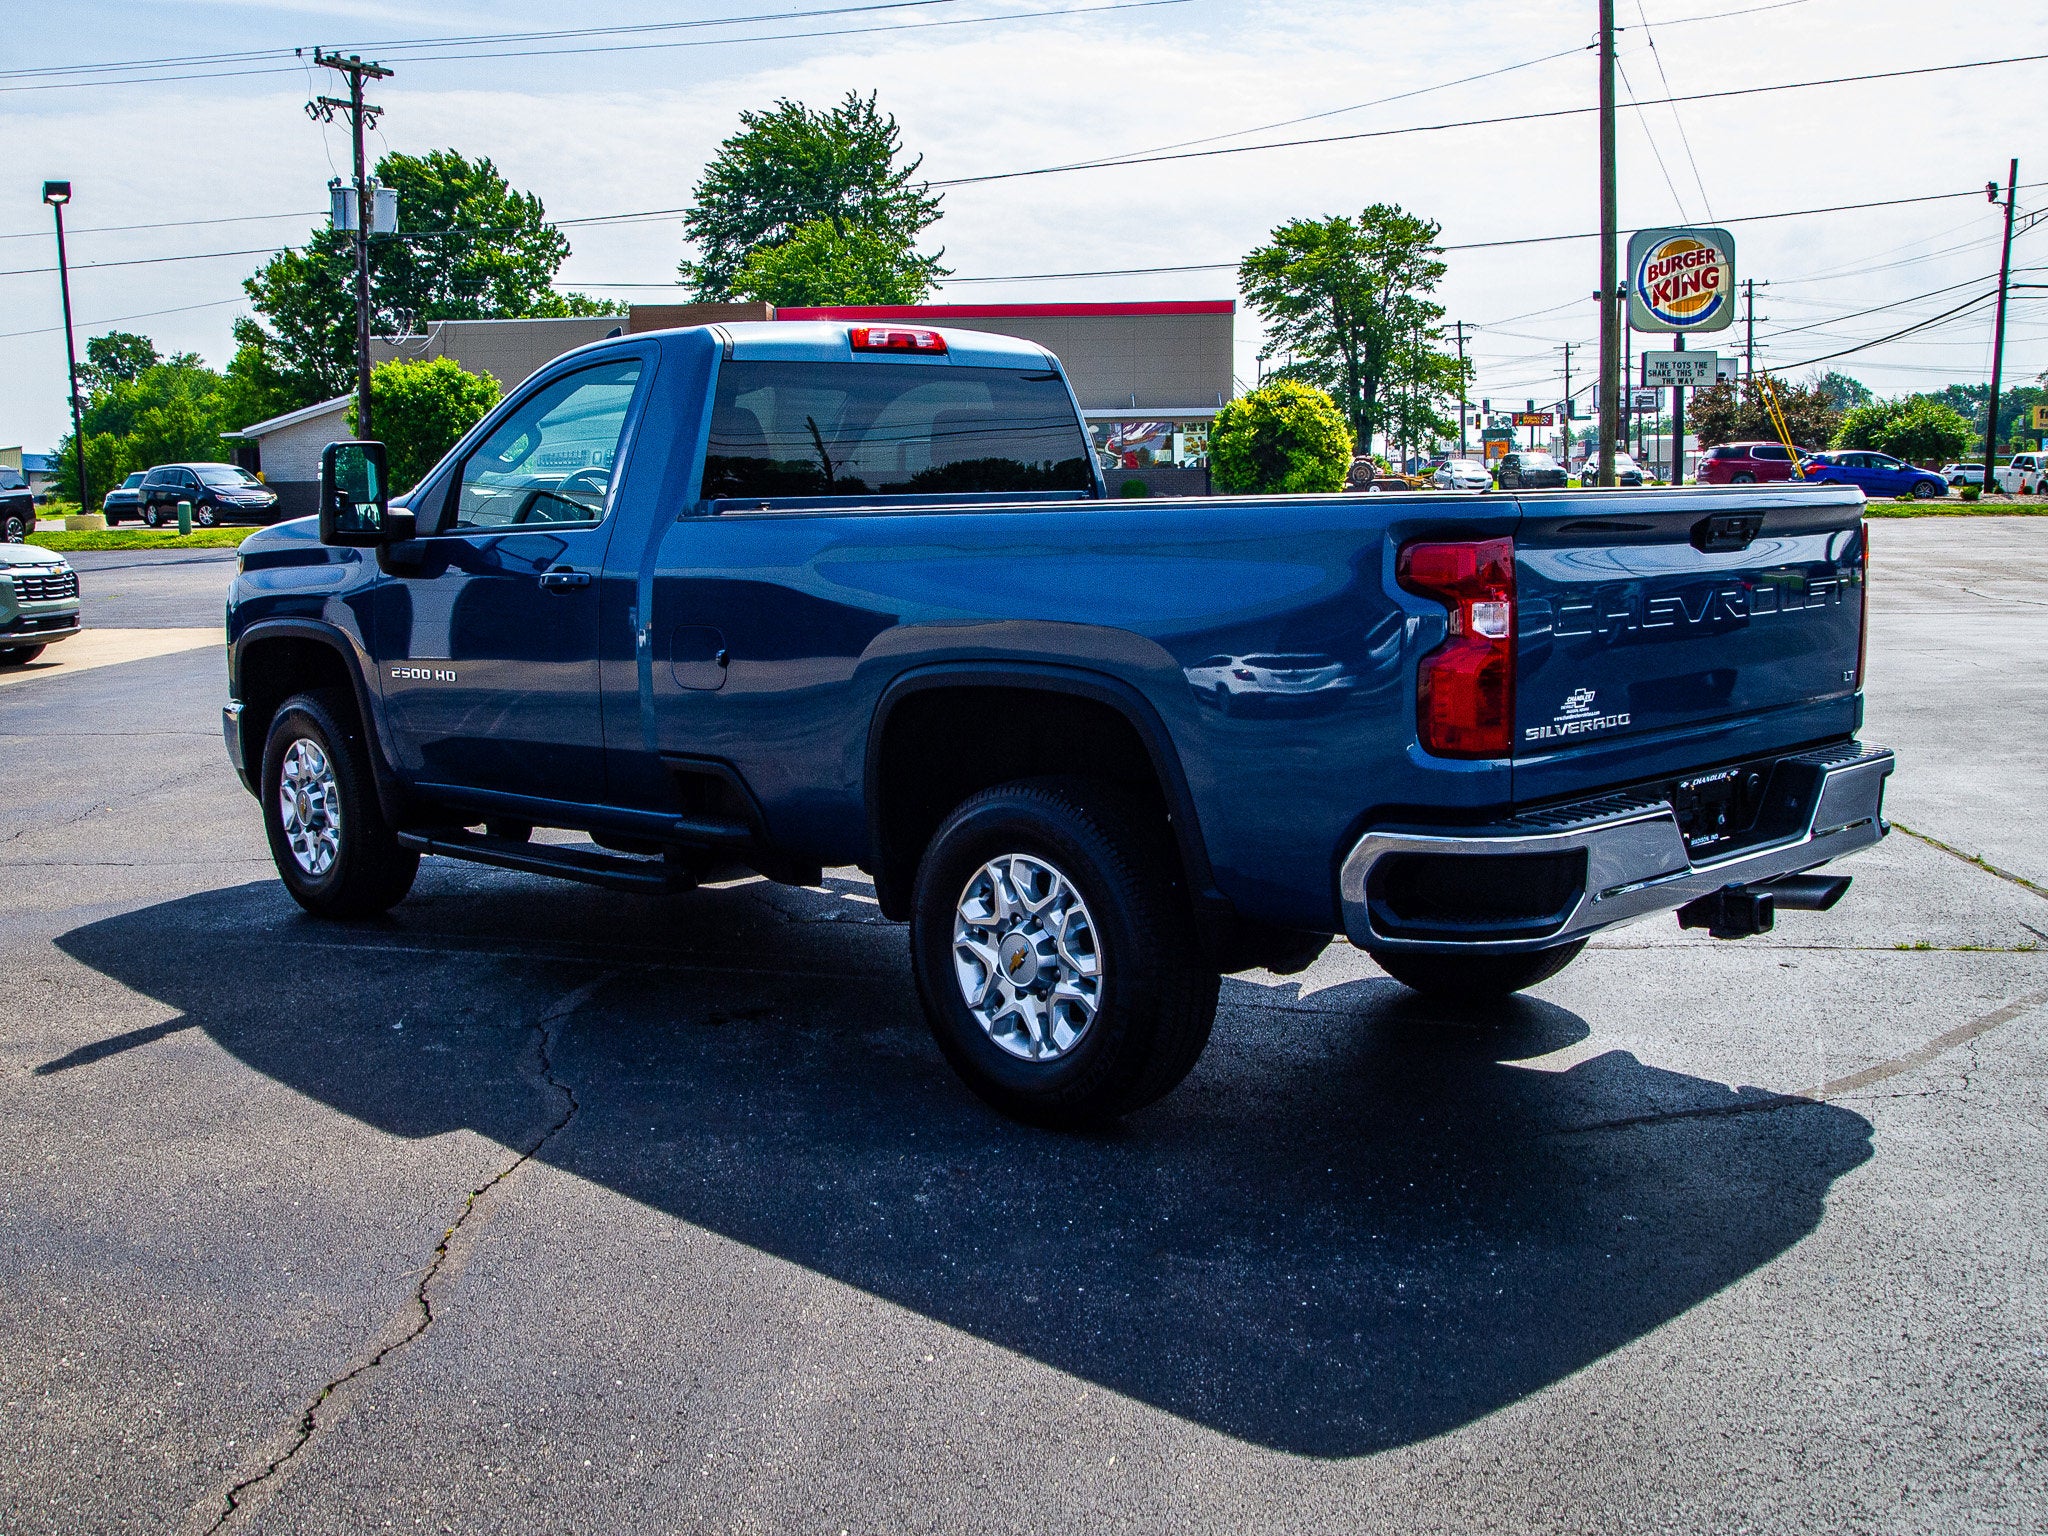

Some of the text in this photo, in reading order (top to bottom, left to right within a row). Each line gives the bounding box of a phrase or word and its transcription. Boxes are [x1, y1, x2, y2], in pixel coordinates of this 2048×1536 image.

[1648, 248, 1716, 283] BURGER
[1652, 266, 1720, 308] KING
[1655, 361, 1708, 369] THE TOTS THE
[1647, 369, 1705, 377] SHAKE THIS IS
[1662, 377, 1695, 385] THE WAY
[1552, 578, 1849, 637] CHEVROLET
[391, 667, 456, 681] 2500 HD
[1842, 670, 1855, 682] LT
[1525, 713, 1631, 741] SILVERADO
[1693, 772, 1727, 785] CHANDLER
